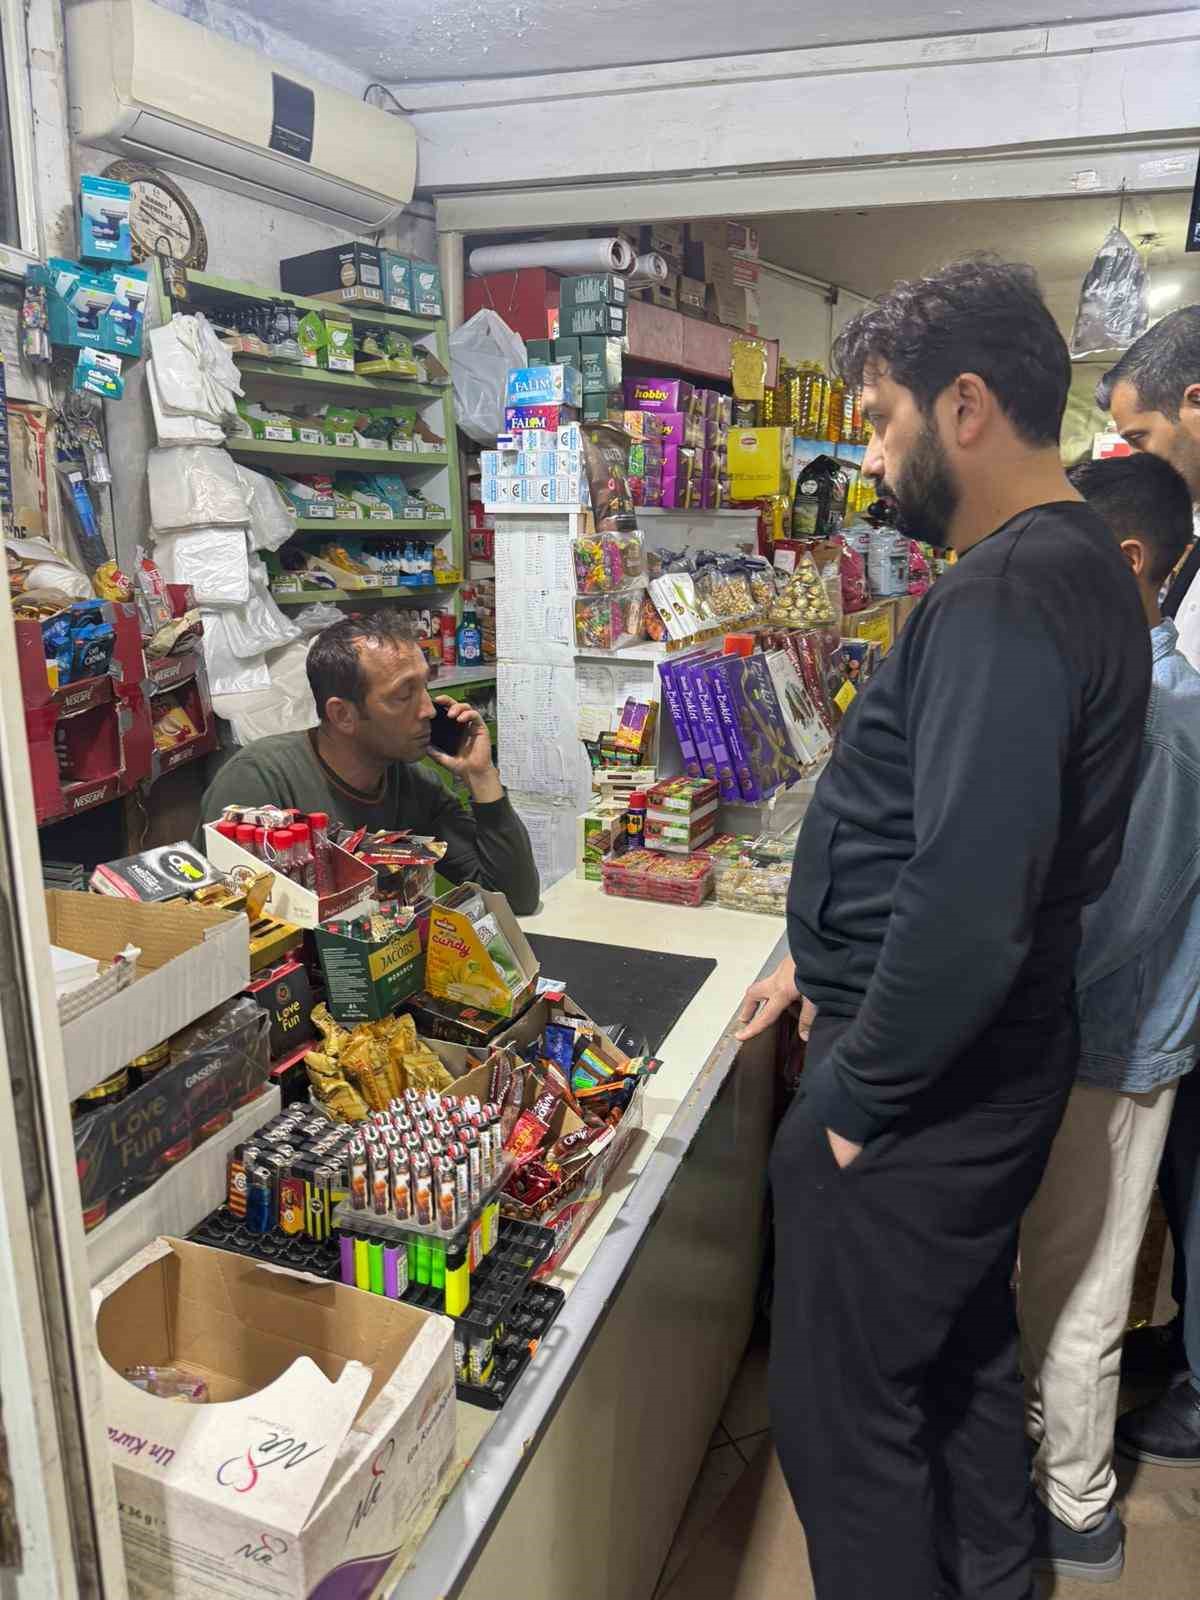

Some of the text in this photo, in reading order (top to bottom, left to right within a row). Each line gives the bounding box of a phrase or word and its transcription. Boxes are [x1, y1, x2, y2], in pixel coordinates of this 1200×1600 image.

[634, 384, 670, 401] hobby
[511, 418, 547, 430] FALM
[73, 787, 108, 808] NESCAFÉ
[381, 940, 414, 972] JACOBS
[432, 935, 472, 958] candy
[276, 1000, 300, 1022] Love
[283, 1014, 300, 1031] Fun
[111, 1095, 168, 1146] Love
[121, 1125, 162, 1168] Fun
[147, 1444, 175, 1467] Un
